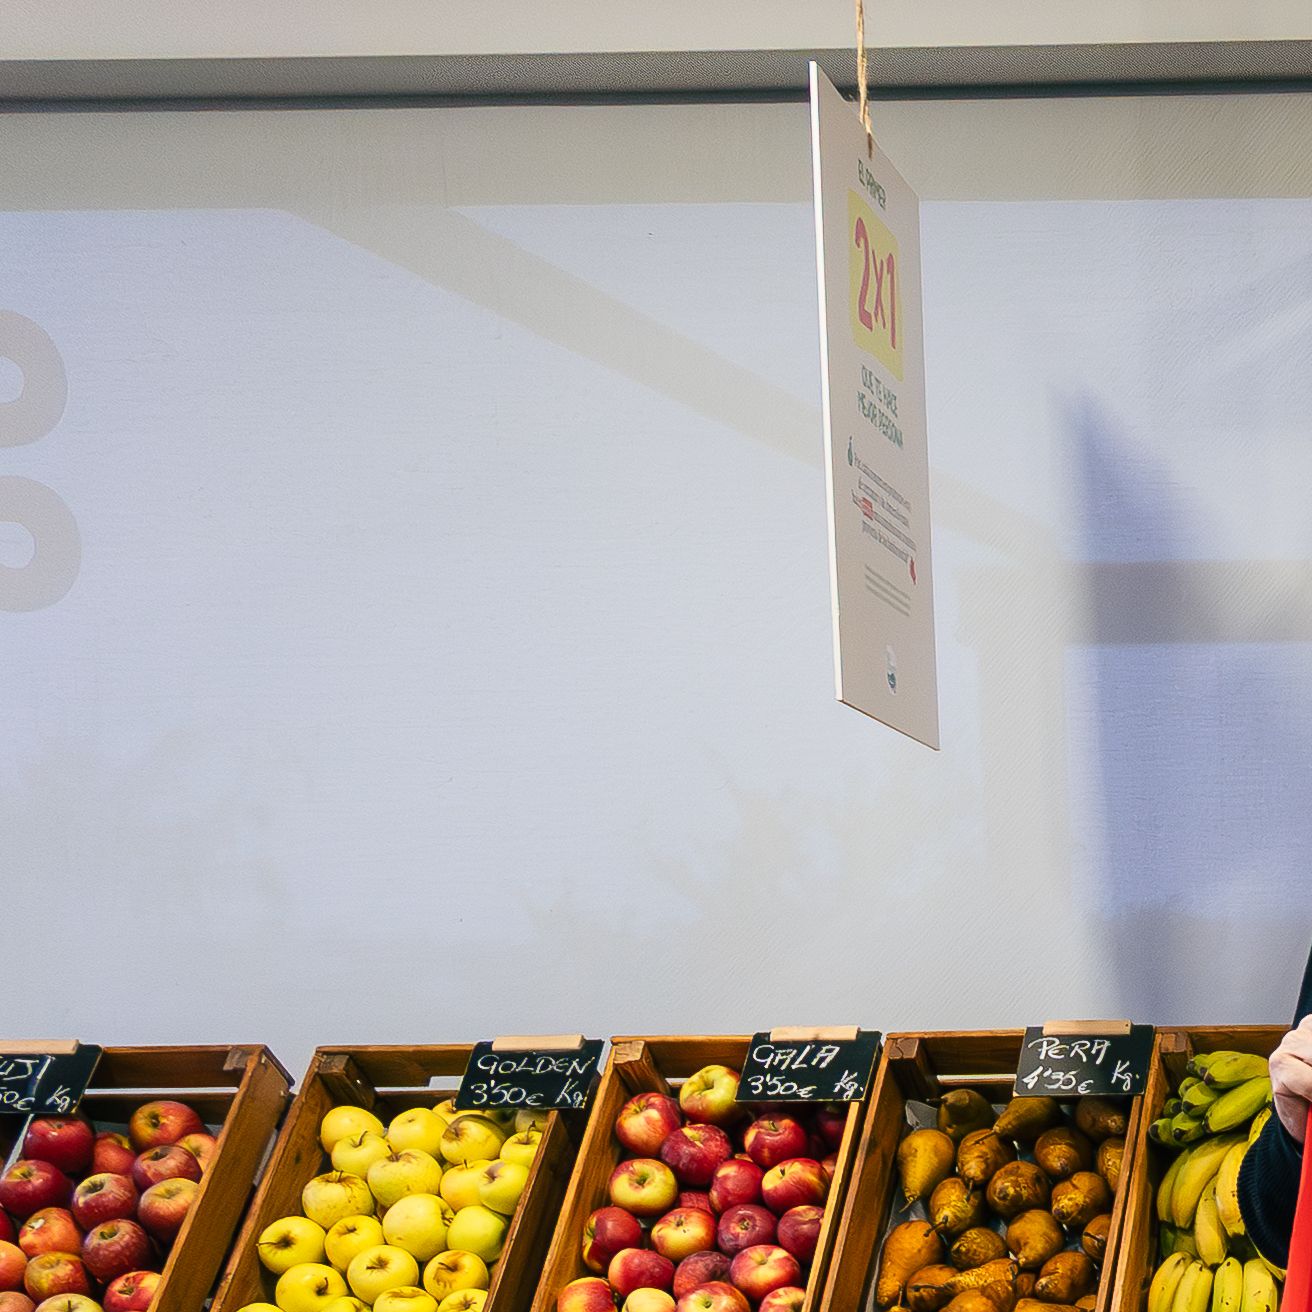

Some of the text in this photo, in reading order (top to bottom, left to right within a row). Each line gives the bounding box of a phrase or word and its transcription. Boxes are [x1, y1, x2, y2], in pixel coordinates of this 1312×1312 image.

[477, 1052, 596, 1077] GOLDEN
[752, 1043, 841, 1071] GALA
[1027, 1036, 1113, 1066] PERA
